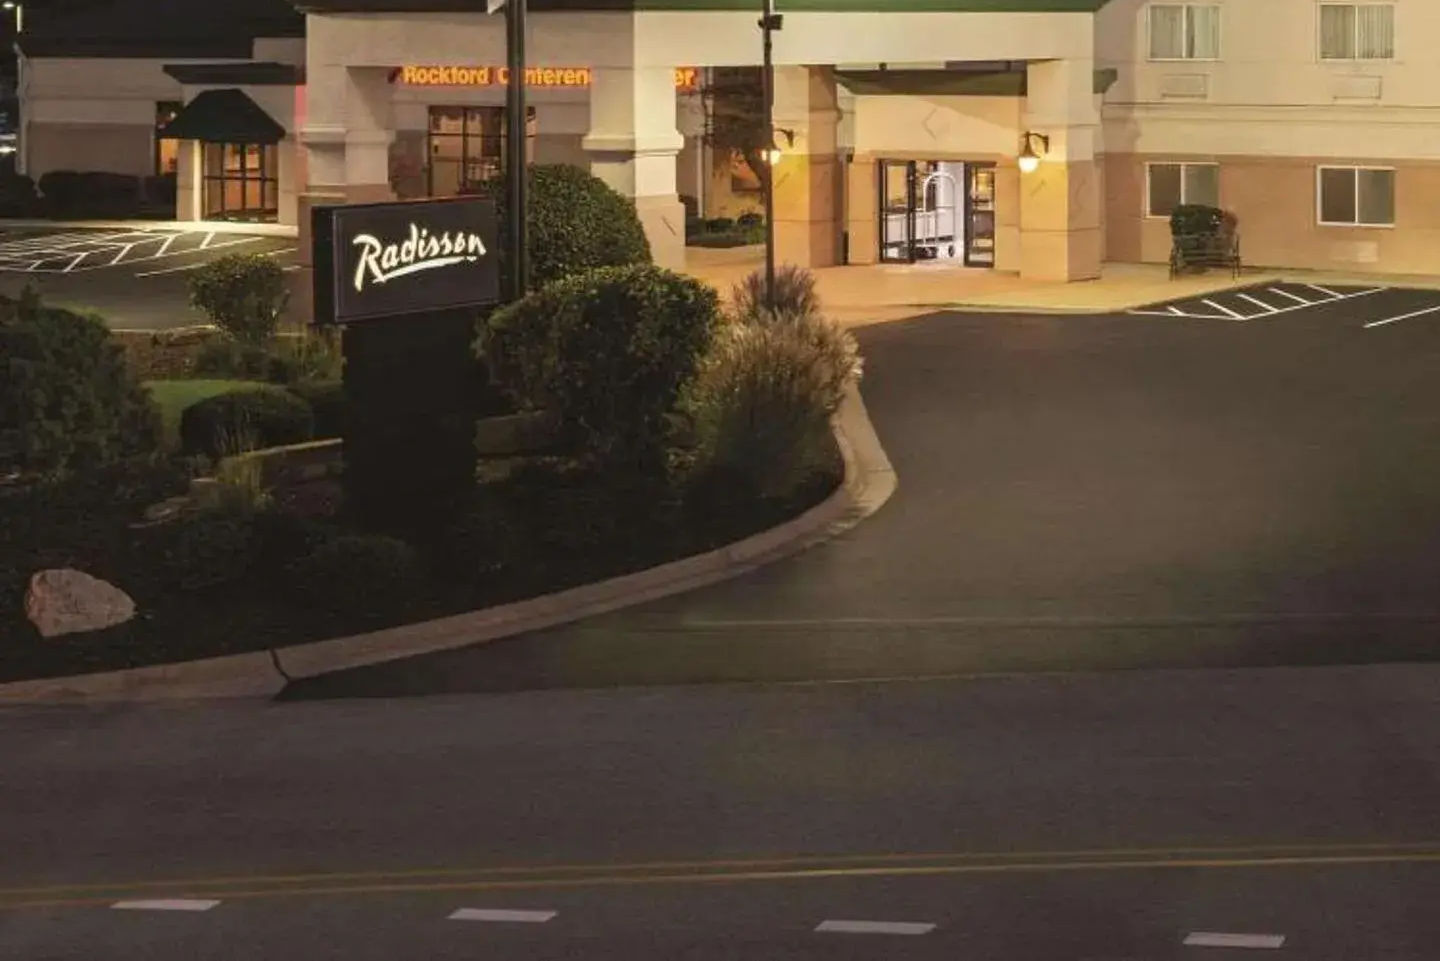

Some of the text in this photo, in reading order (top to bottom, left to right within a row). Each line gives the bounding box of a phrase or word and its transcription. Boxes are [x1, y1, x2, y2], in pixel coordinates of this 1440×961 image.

[404, 66, 592, 85] Rockford Cnferen
[352, 222, 487, 292] Radisson
